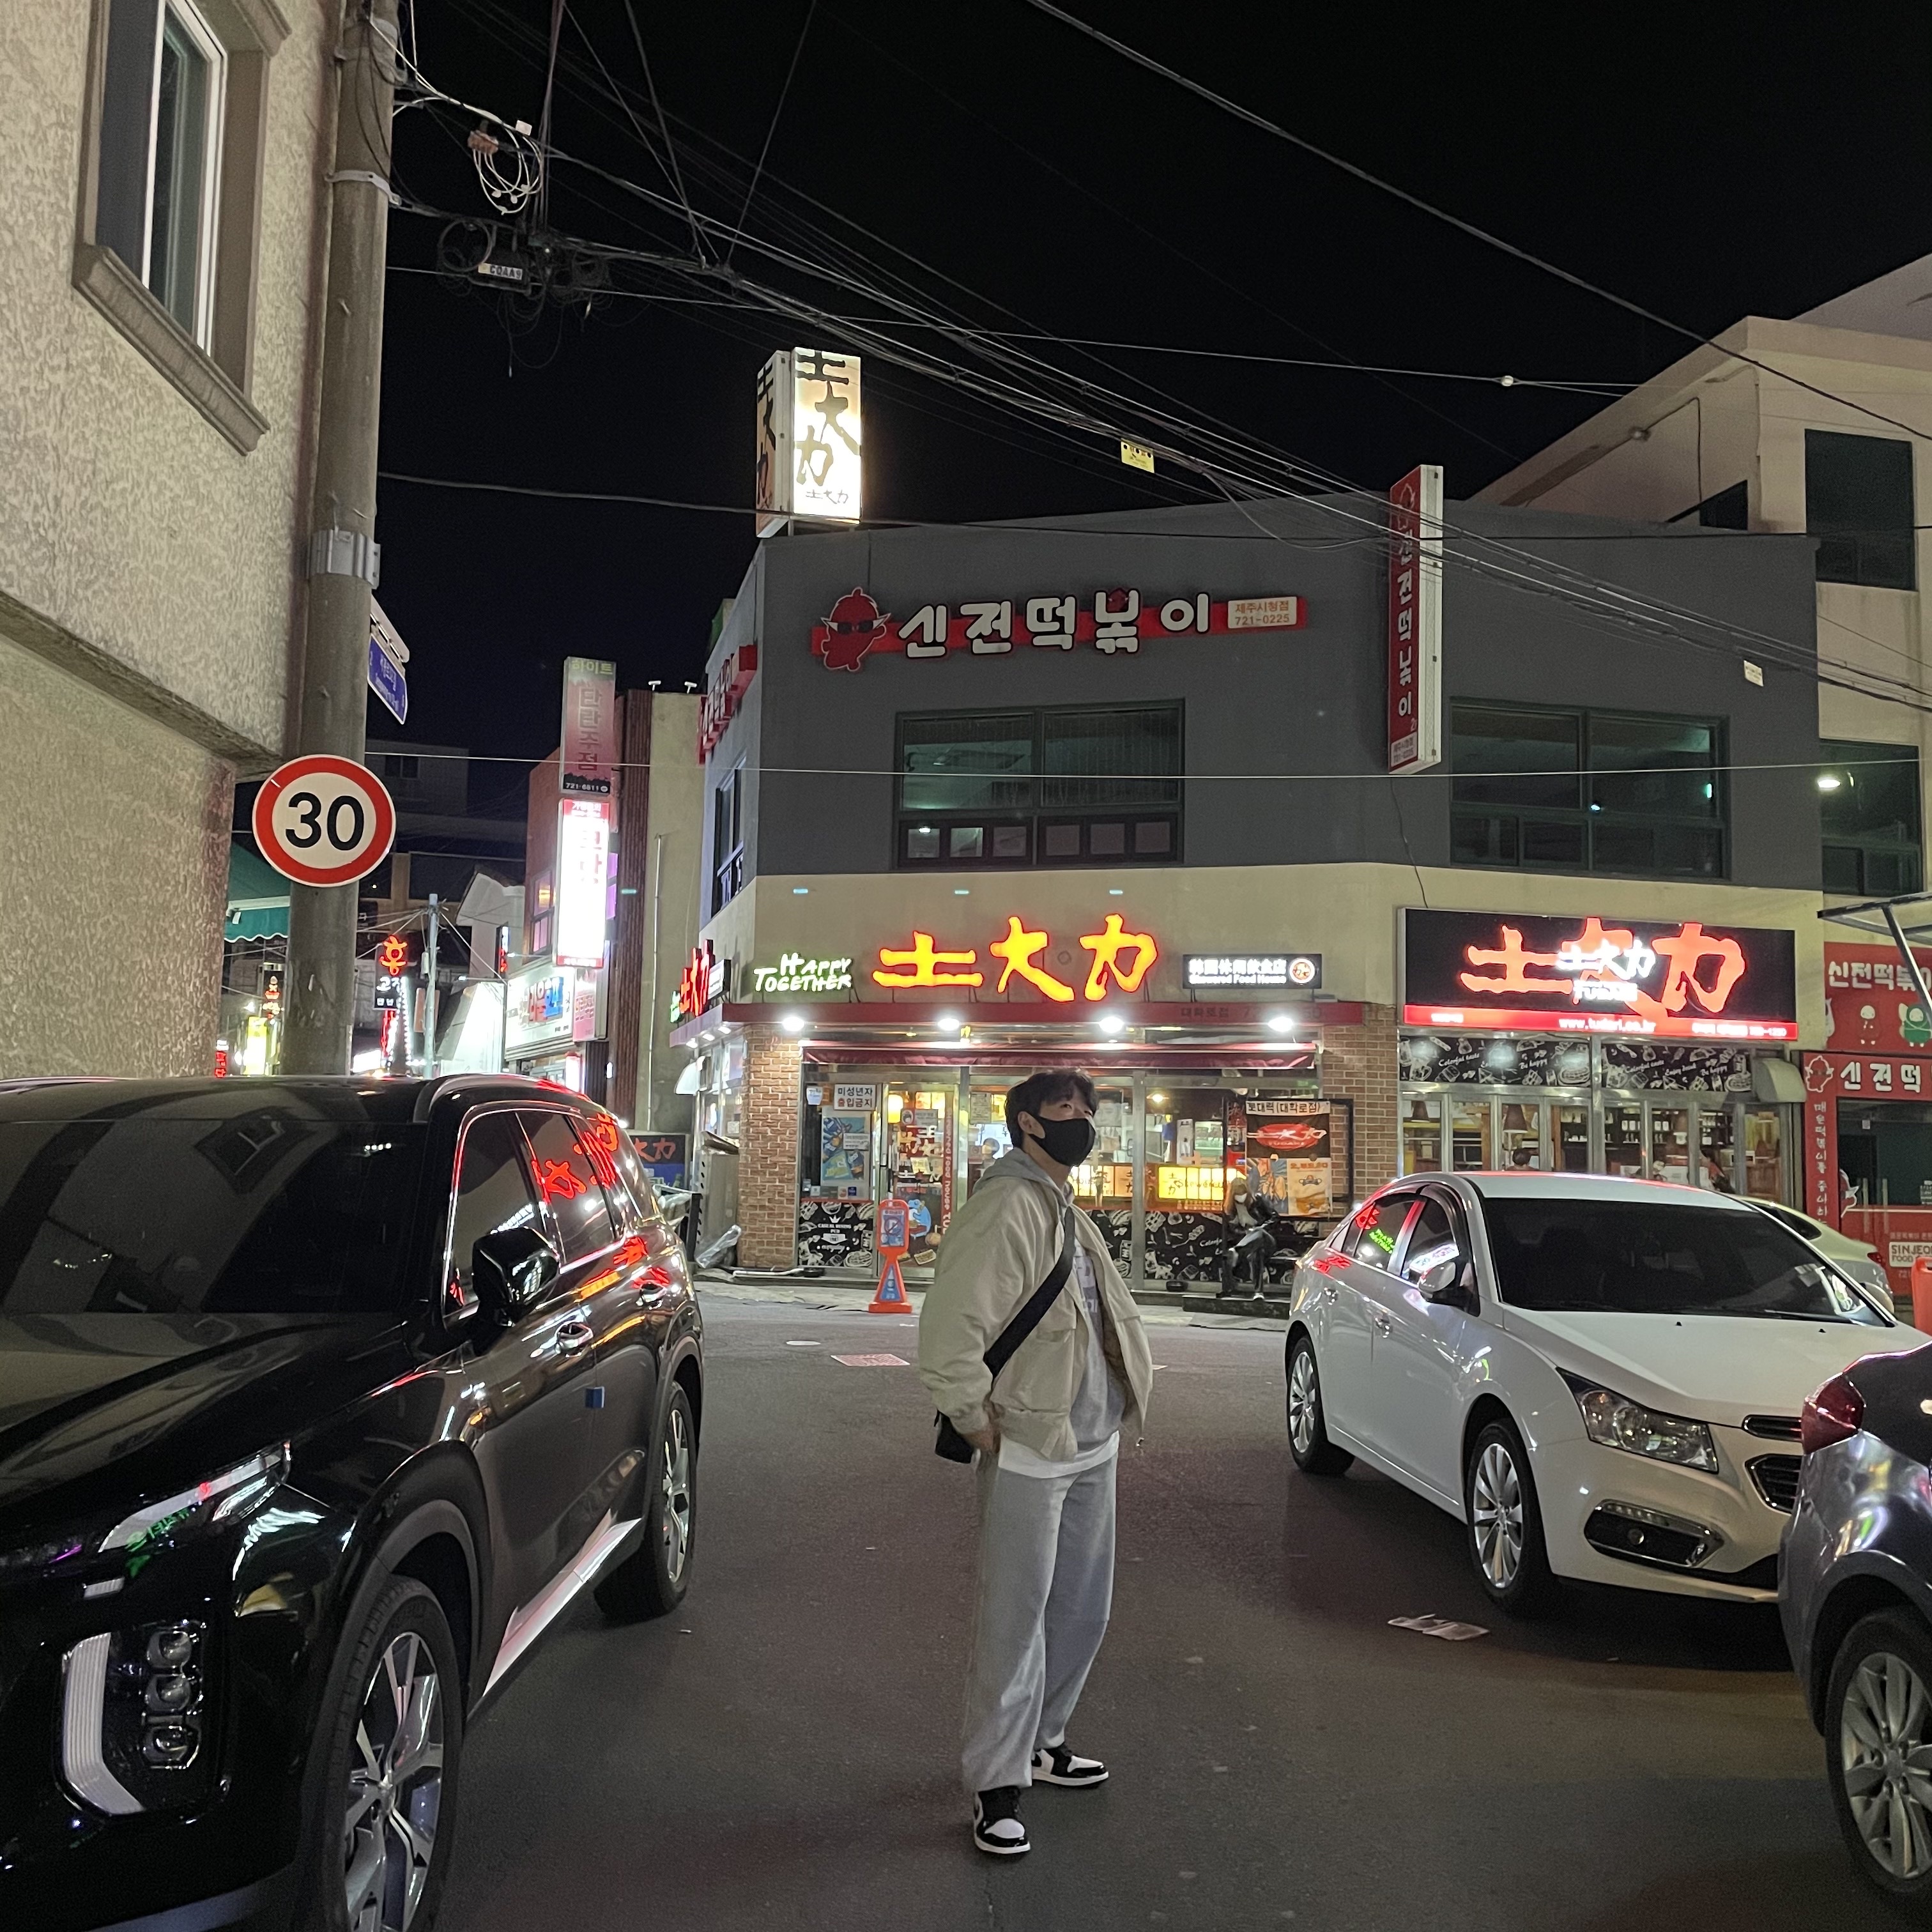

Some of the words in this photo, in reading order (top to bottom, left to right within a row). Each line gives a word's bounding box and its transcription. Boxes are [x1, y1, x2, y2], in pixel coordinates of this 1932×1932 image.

[1235, 601, 1289, 614] 제주시청점
[1235, 614, 1290, 625] 721-0225
[897, 592, 1210, 659] 신전떡볶이
[571, 660, 613, 675] 하이트
[578, 687, 603, 770] 단란주점
[284, 792, 365, 851] 30
[780, 952, 852, 976] HAPPY
[871, 914, 1158, 1002] 土大力
[753, 967, 852, 992] TOGETHER
[838, 1087, 873, 1097] 미성년자
[838, 1097, 873, 1107] 출입금지
